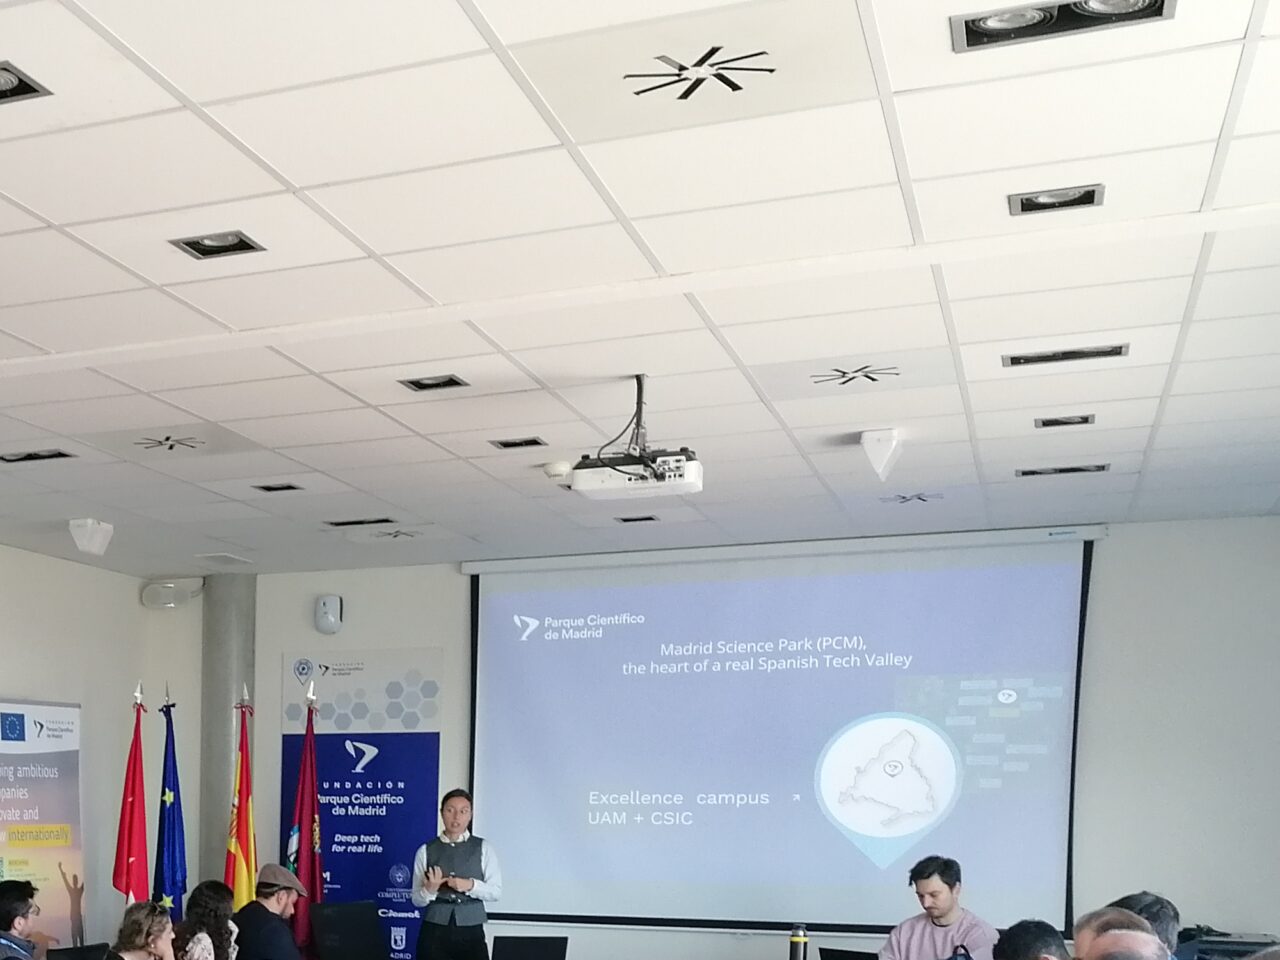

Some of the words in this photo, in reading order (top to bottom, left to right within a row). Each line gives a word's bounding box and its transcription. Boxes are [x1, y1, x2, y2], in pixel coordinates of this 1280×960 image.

[544, 616, 584, 630] Parque
[587, 613, 645, 626] Científico
[544, 629, 559, 641] de
[561, 627, 603, 640] Madrid
[660, 641, 713, 656] Madrid
[716, 640, 774, 654] Science
[778, 637, 813, 652] Park
[816, 635, 867, 653] (PCM),
[622, 662, 646, 675] the
[650, 660, 689, 674] heart
[693, 659, 712, 673] of
[712, 662, 721, 672] a
[725, 657, 754, 671] real
[758, 655, 819, 673] Spanish
[822, 653, 861, 669] Tech
[865, 652, 913, 670] Valley
[17, 763, 59, 778] ambitious
[322, 781, 405, 789] UNDACIÓN
[351, 793, 405, 804] Científico
[589, 791, 684, 805] Excellence
[696, 793, 770, 808] campus
[23, 806, 39, 820] and
[331, 805, 346, 816] de
[347, 805, 387, 816] Madrid
[588, 811, 627, 825] UAM
[633, 814, 644, 823] +
[650, 811, 694, 825] CSIC
[8, 827, 69, 843] internationally
[334, 833, 359, 844] Deep
[360, 834, 381, 843] tech
[331, 844, 346, 853] for
[347, 844, 366, 853] real
[367, 844, 383, 853] life
